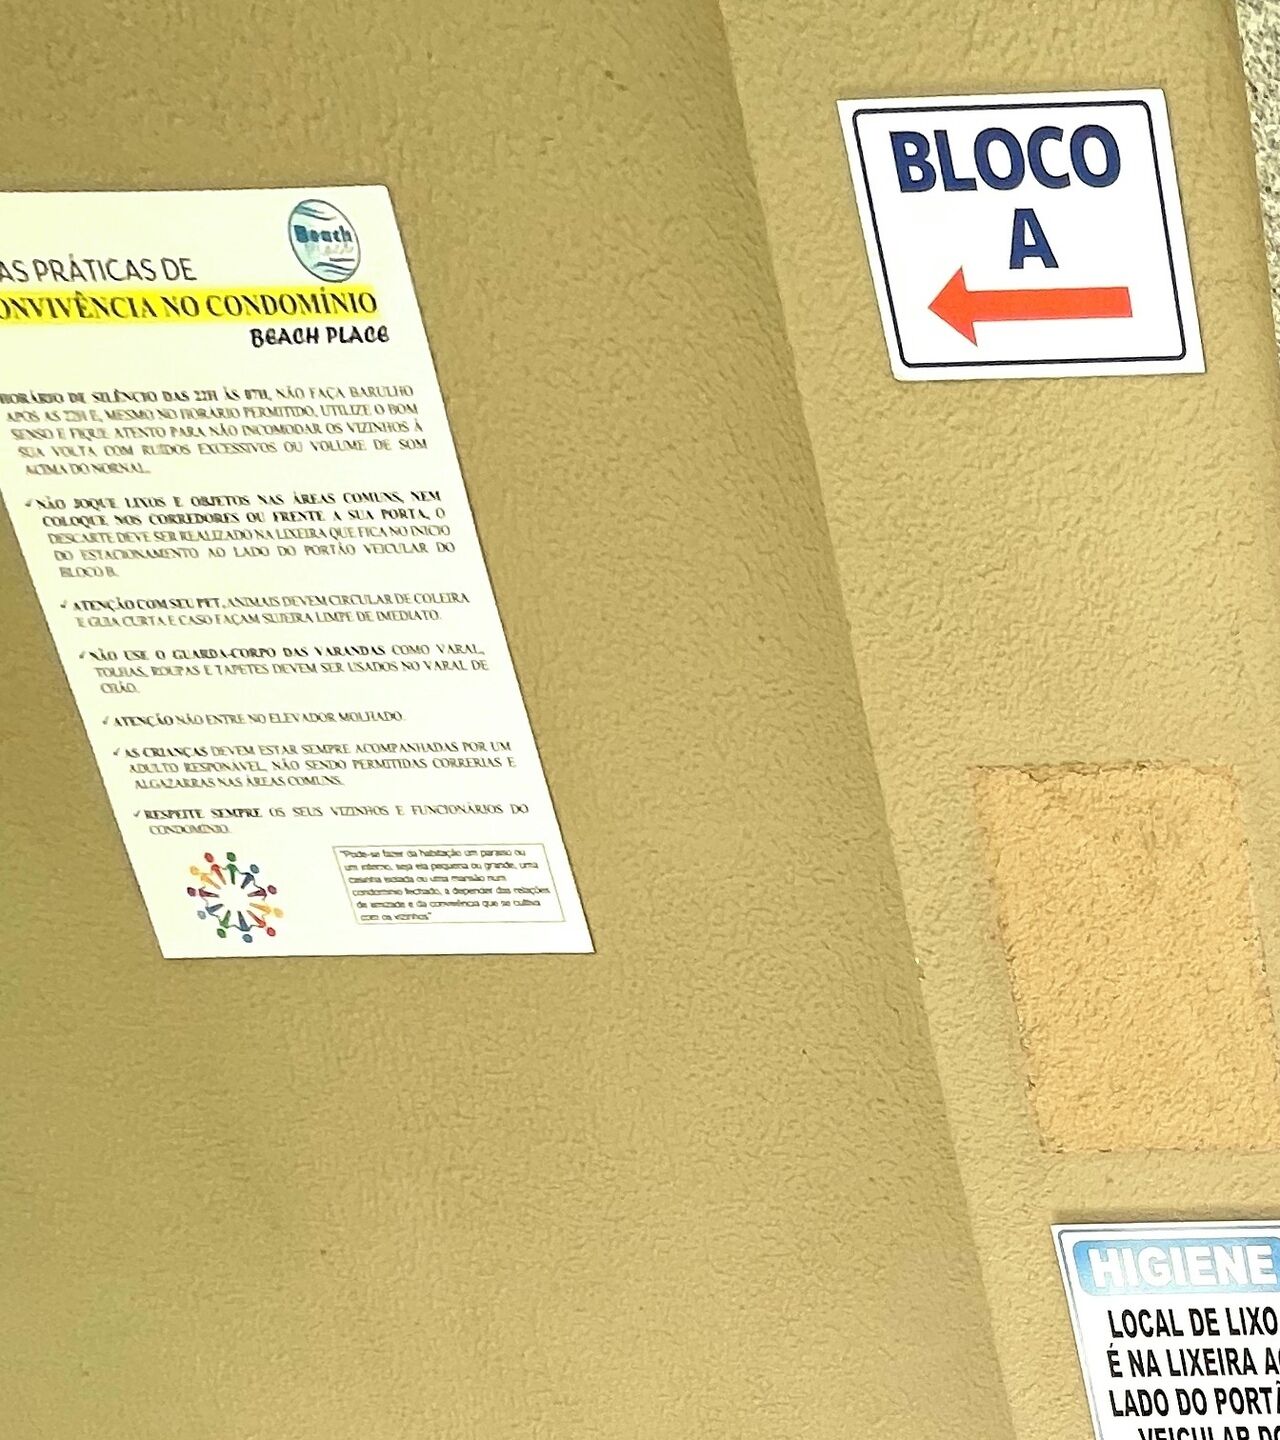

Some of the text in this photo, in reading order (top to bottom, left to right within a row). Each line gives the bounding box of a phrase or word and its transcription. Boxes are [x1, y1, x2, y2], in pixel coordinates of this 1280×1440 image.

[889, 124, 1121, 193] BLOCO
[1009, 208, 1059, 270] A
[32, 253, 157, 282] PRÁTICAS
[160, 257, 197, 281] DE
[160, 295, 200, 317] NO
[206, 286, 377, 317] CONDOMÍNIO
[249, 325, 390, 348] BEACH PLACE
[1087, 1244, 1278, 1288] HIGIENE
[1108, 1306, 1278, 1338] LOCAL DE LIXO
[1107, 1343, 1123, 1378] É
[1128, 1349, 1162, 1378] NA
[1166, 1347, 1258, 1377] LIXEIRA
[1109, 1388, 1169, 1417] LADO
[1175, 1387, 1208, 1416] DO
